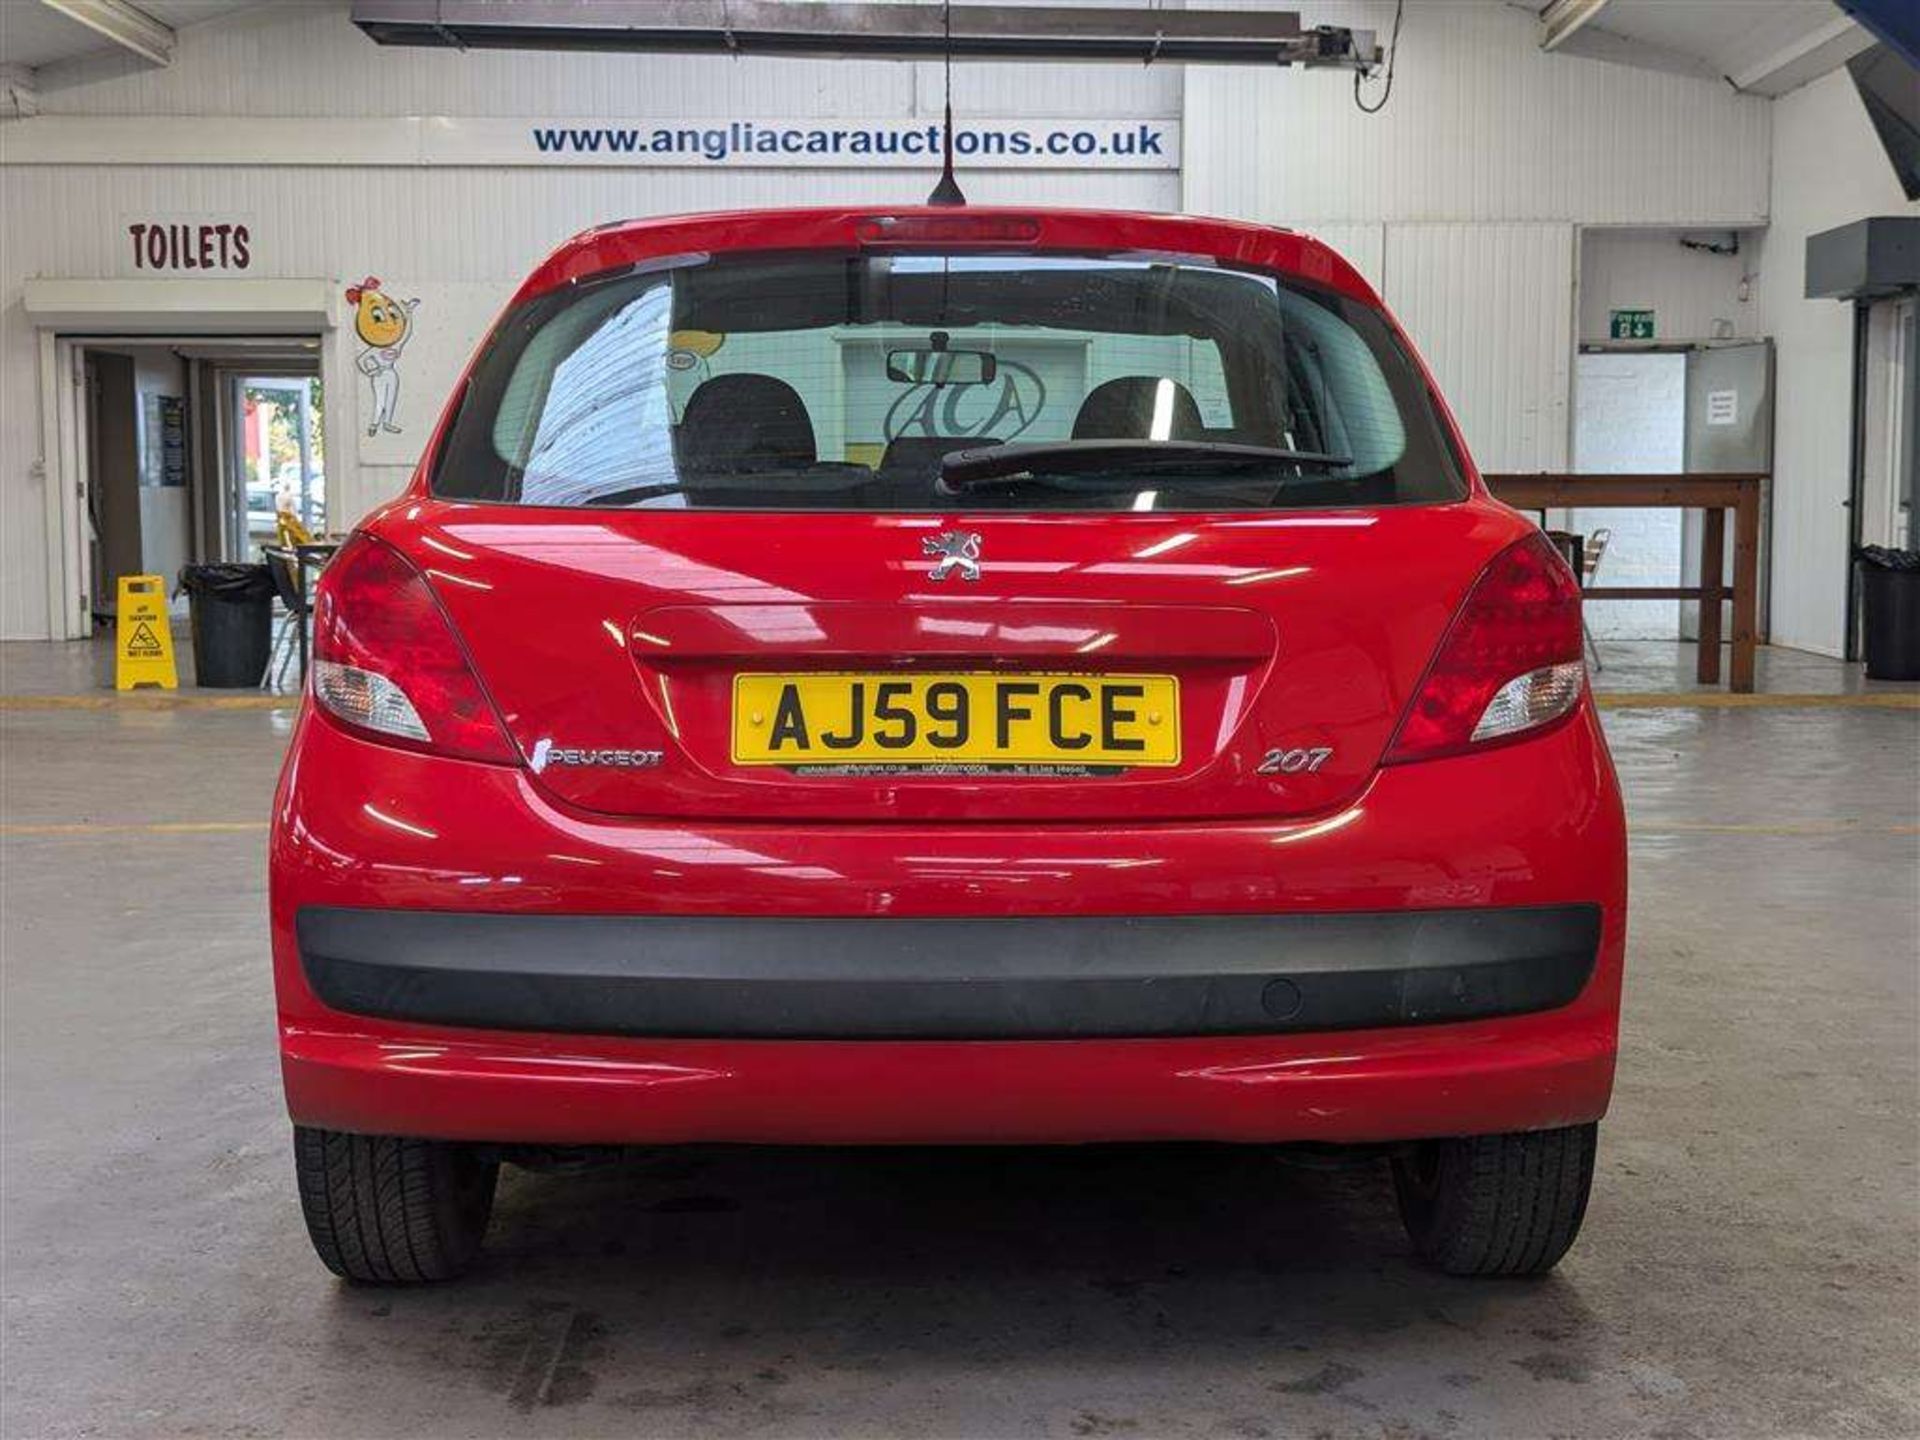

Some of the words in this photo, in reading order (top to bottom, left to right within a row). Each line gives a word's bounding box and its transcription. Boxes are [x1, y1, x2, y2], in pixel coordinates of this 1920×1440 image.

[533, 122, 1163, 160] www.angliacarauctons.co.uk
[129, 224, 250, 269] TOILETS
[896, 372, 1028, 438] ACA
[768, 682, 970, 751] AJ59
[996, 682, 1146, 751] FCE
[547, 748, 664, 766] PEUGEOT
[1257, 747, 1334, 773] 207
